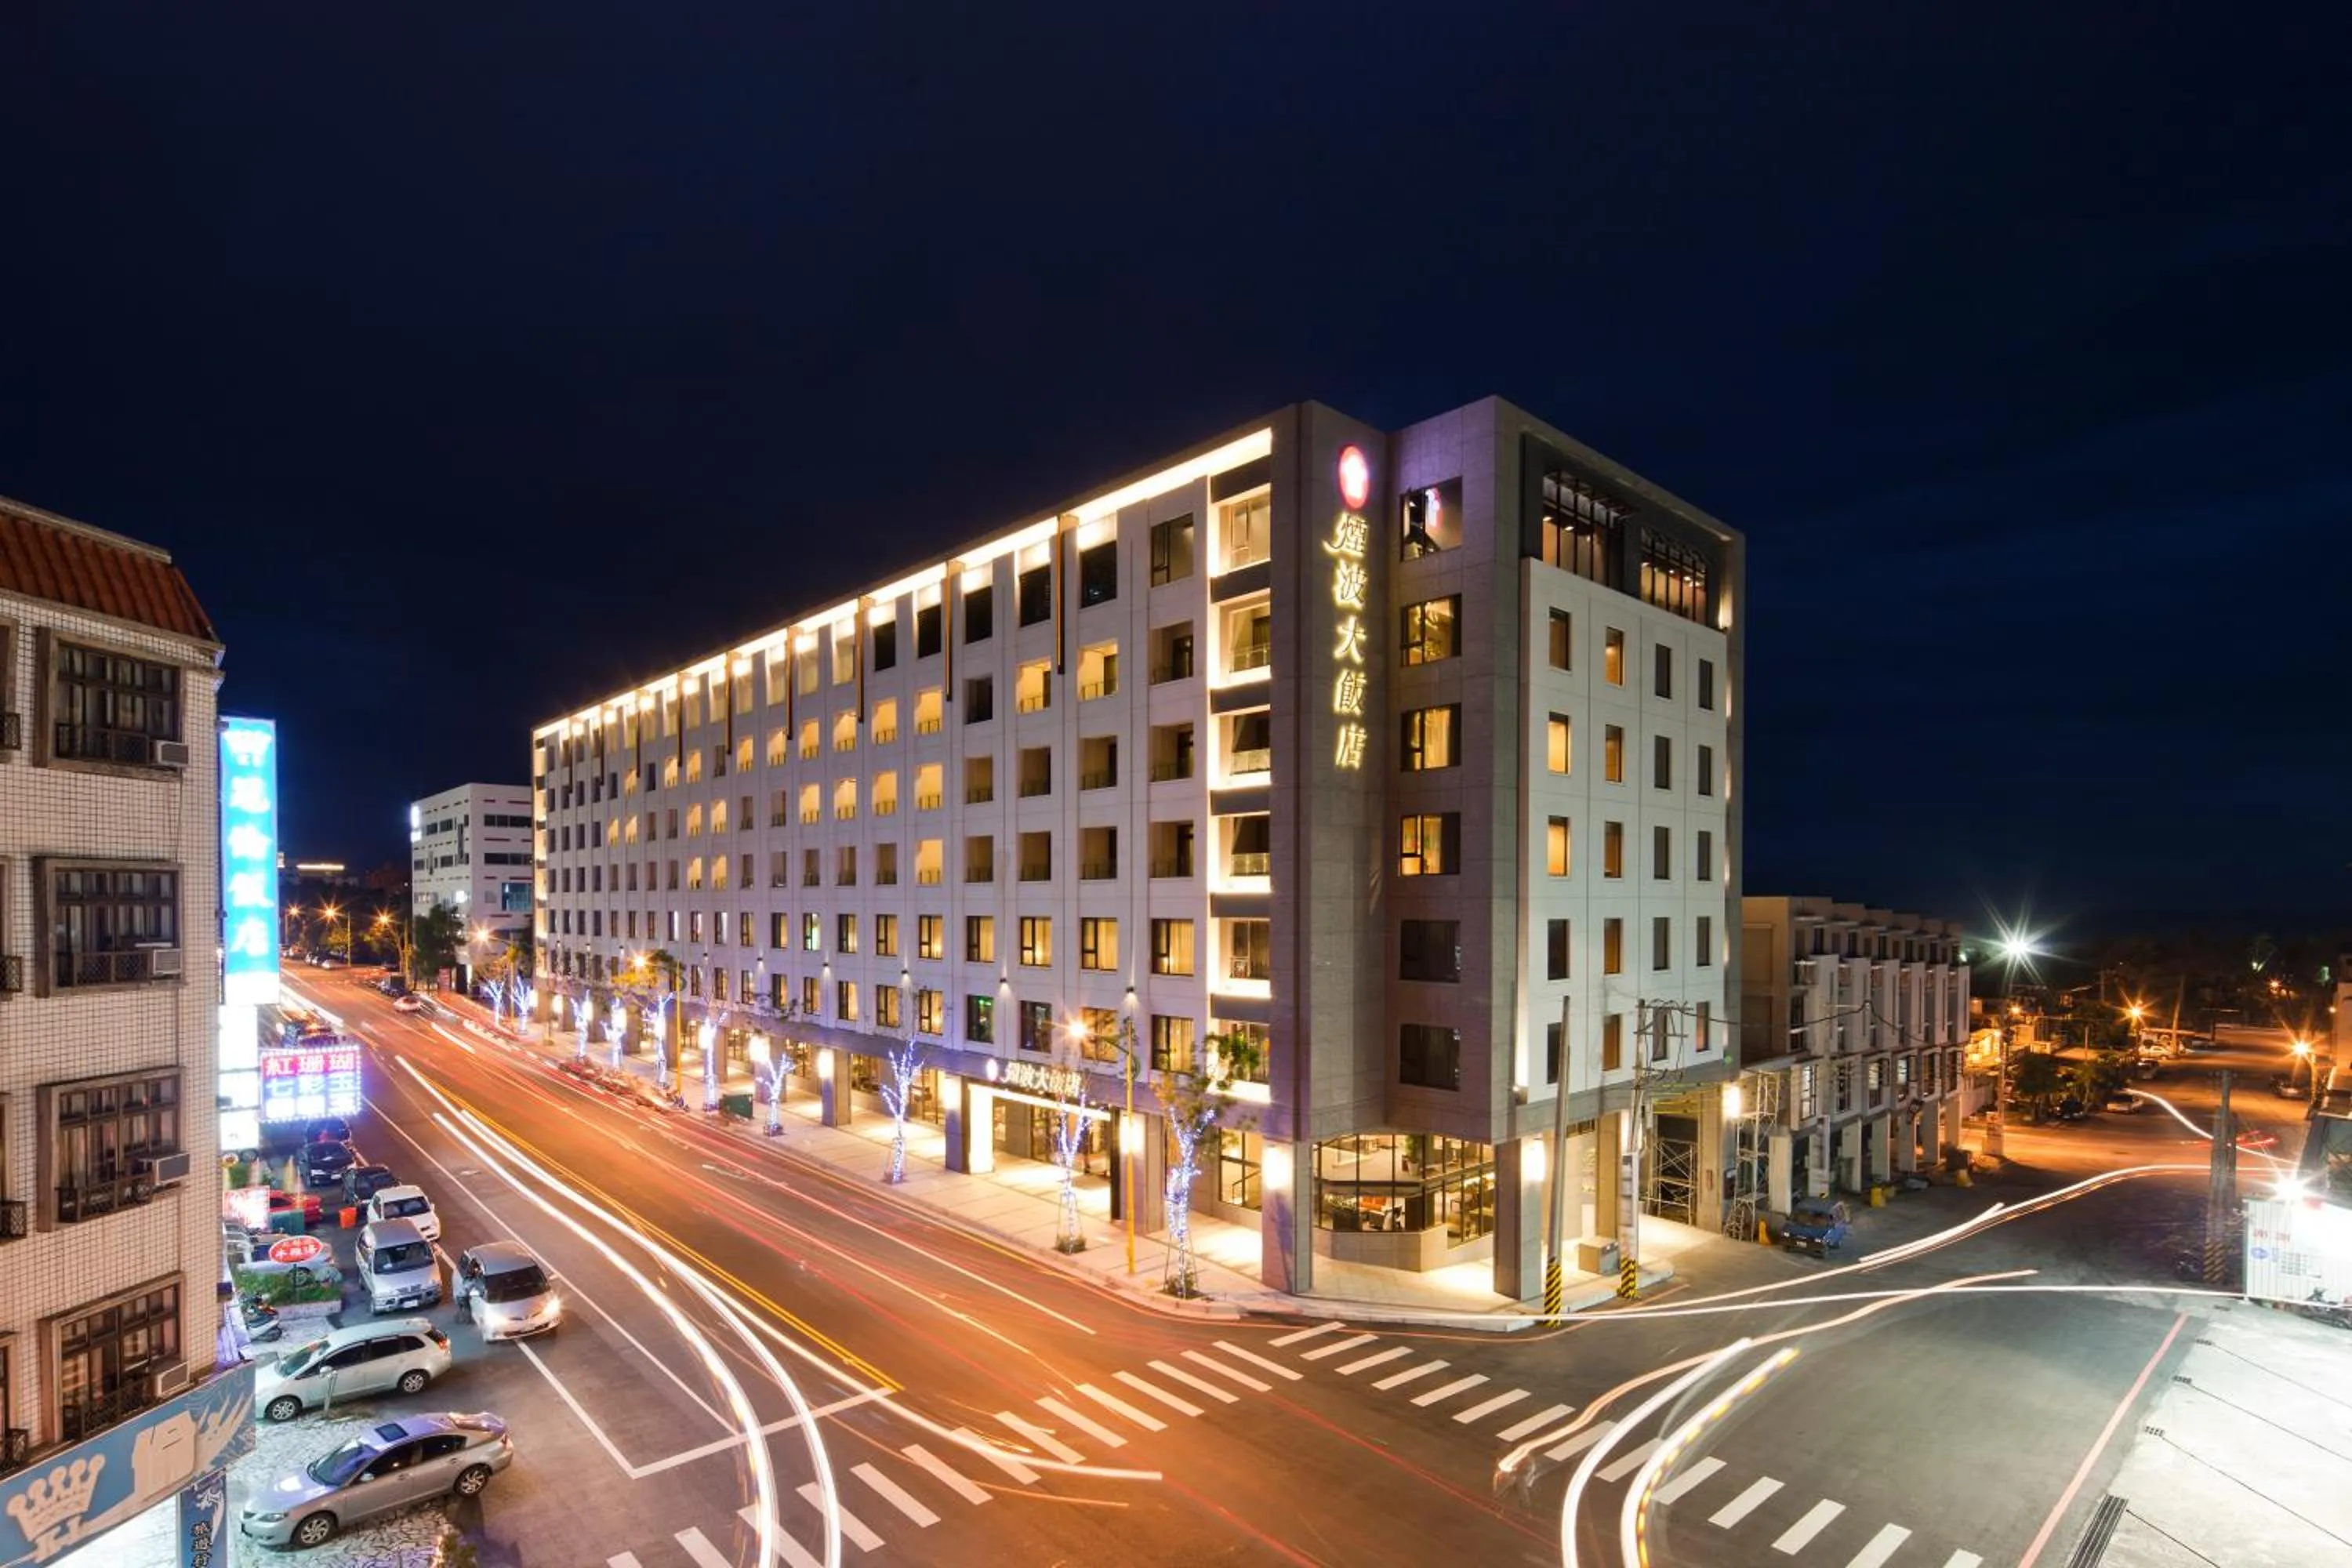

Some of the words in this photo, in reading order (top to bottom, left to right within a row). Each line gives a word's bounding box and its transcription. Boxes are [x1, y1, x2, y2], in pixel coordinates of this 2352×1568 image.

[1323, 513, 1368, 769] 煙波大飯店
[266, 1053, 354, 1076] 紅珊瑚
